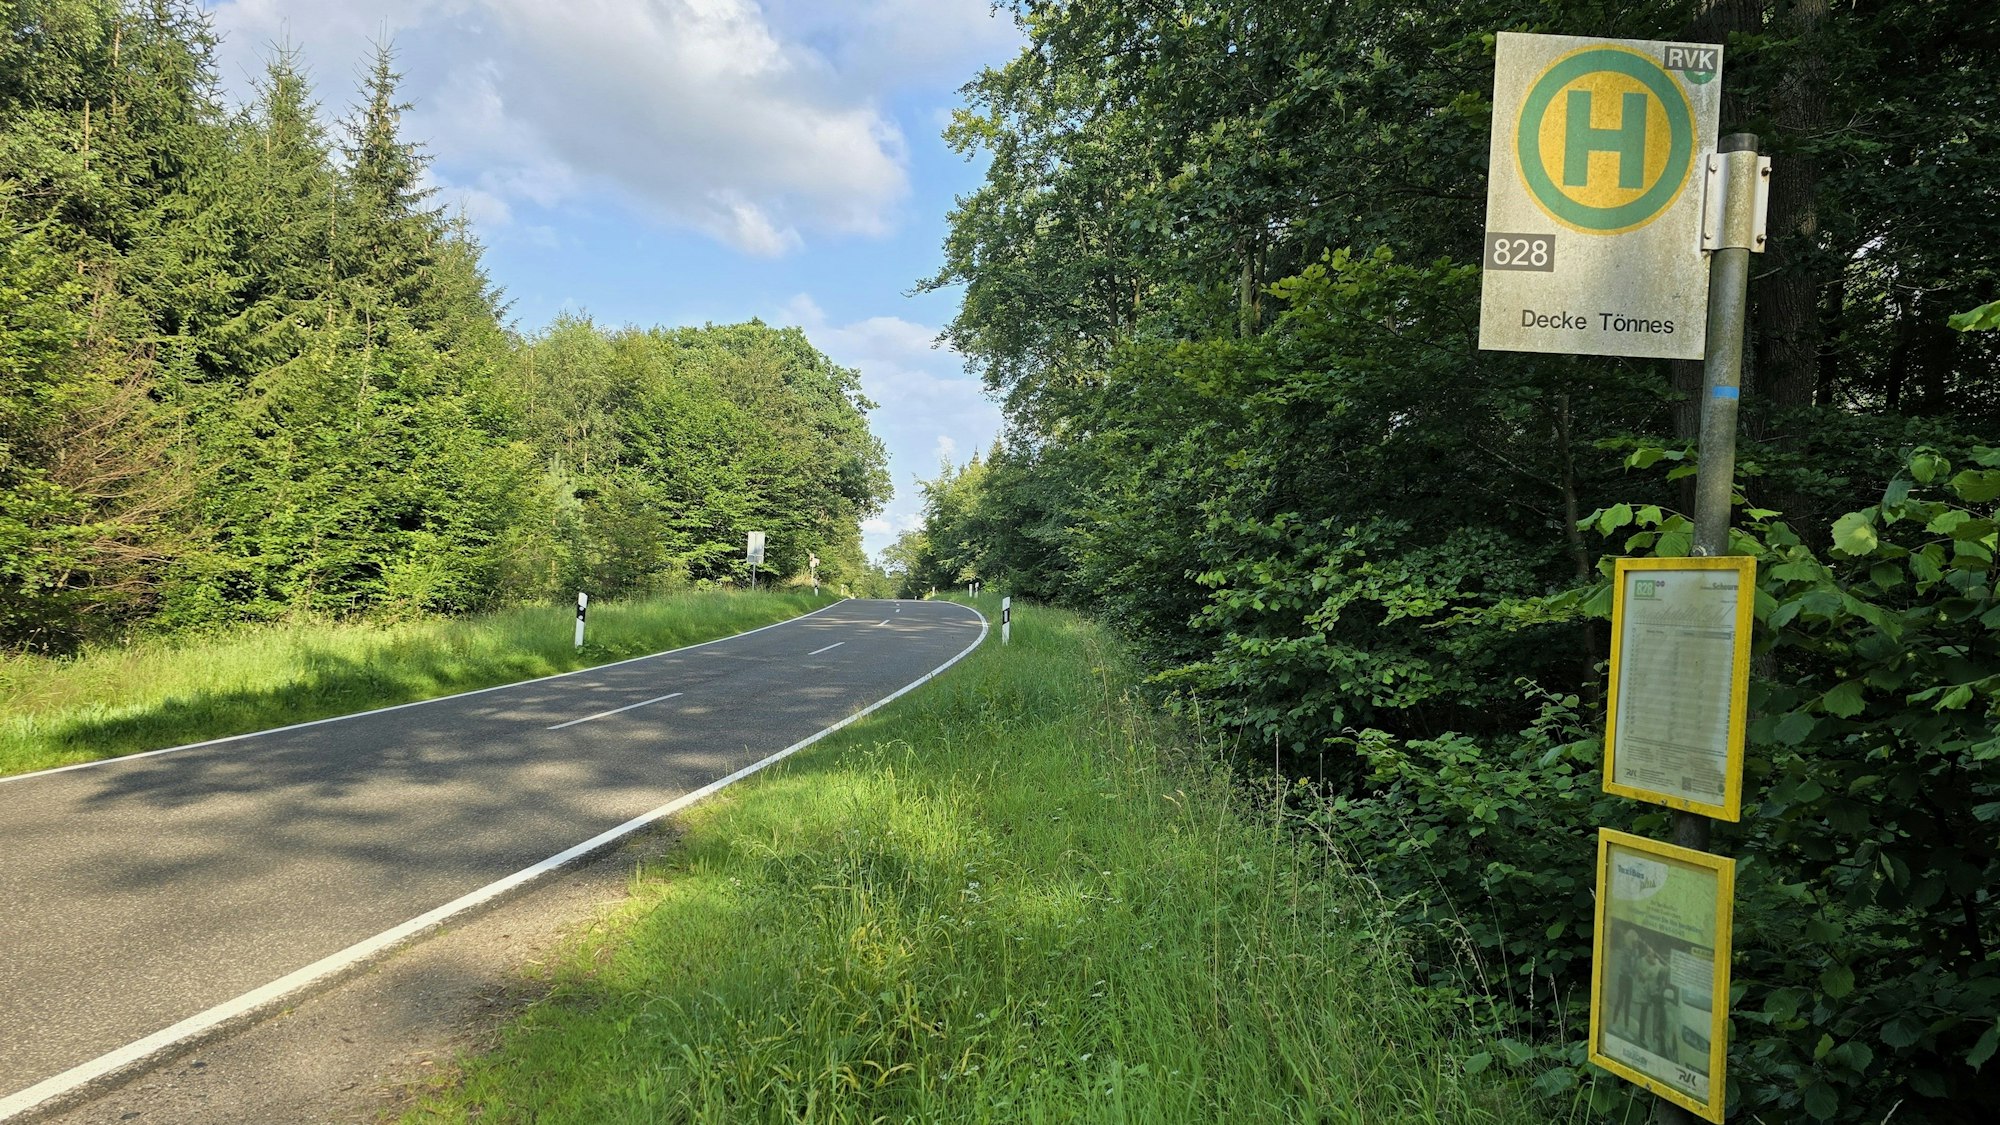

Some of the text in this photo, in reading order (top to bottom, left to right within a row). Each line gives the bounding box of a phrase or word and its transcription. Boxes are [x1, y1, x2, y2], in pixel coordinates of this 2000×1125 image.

[1667, 47, 1715, 70] RVK
[1562, 89, 1648, 189] H
[1492, 238, 1548, 267] 828
[1521, 309, 1675, 334] Decke Tönnes
[1636, 581, 1653, 596] 828
